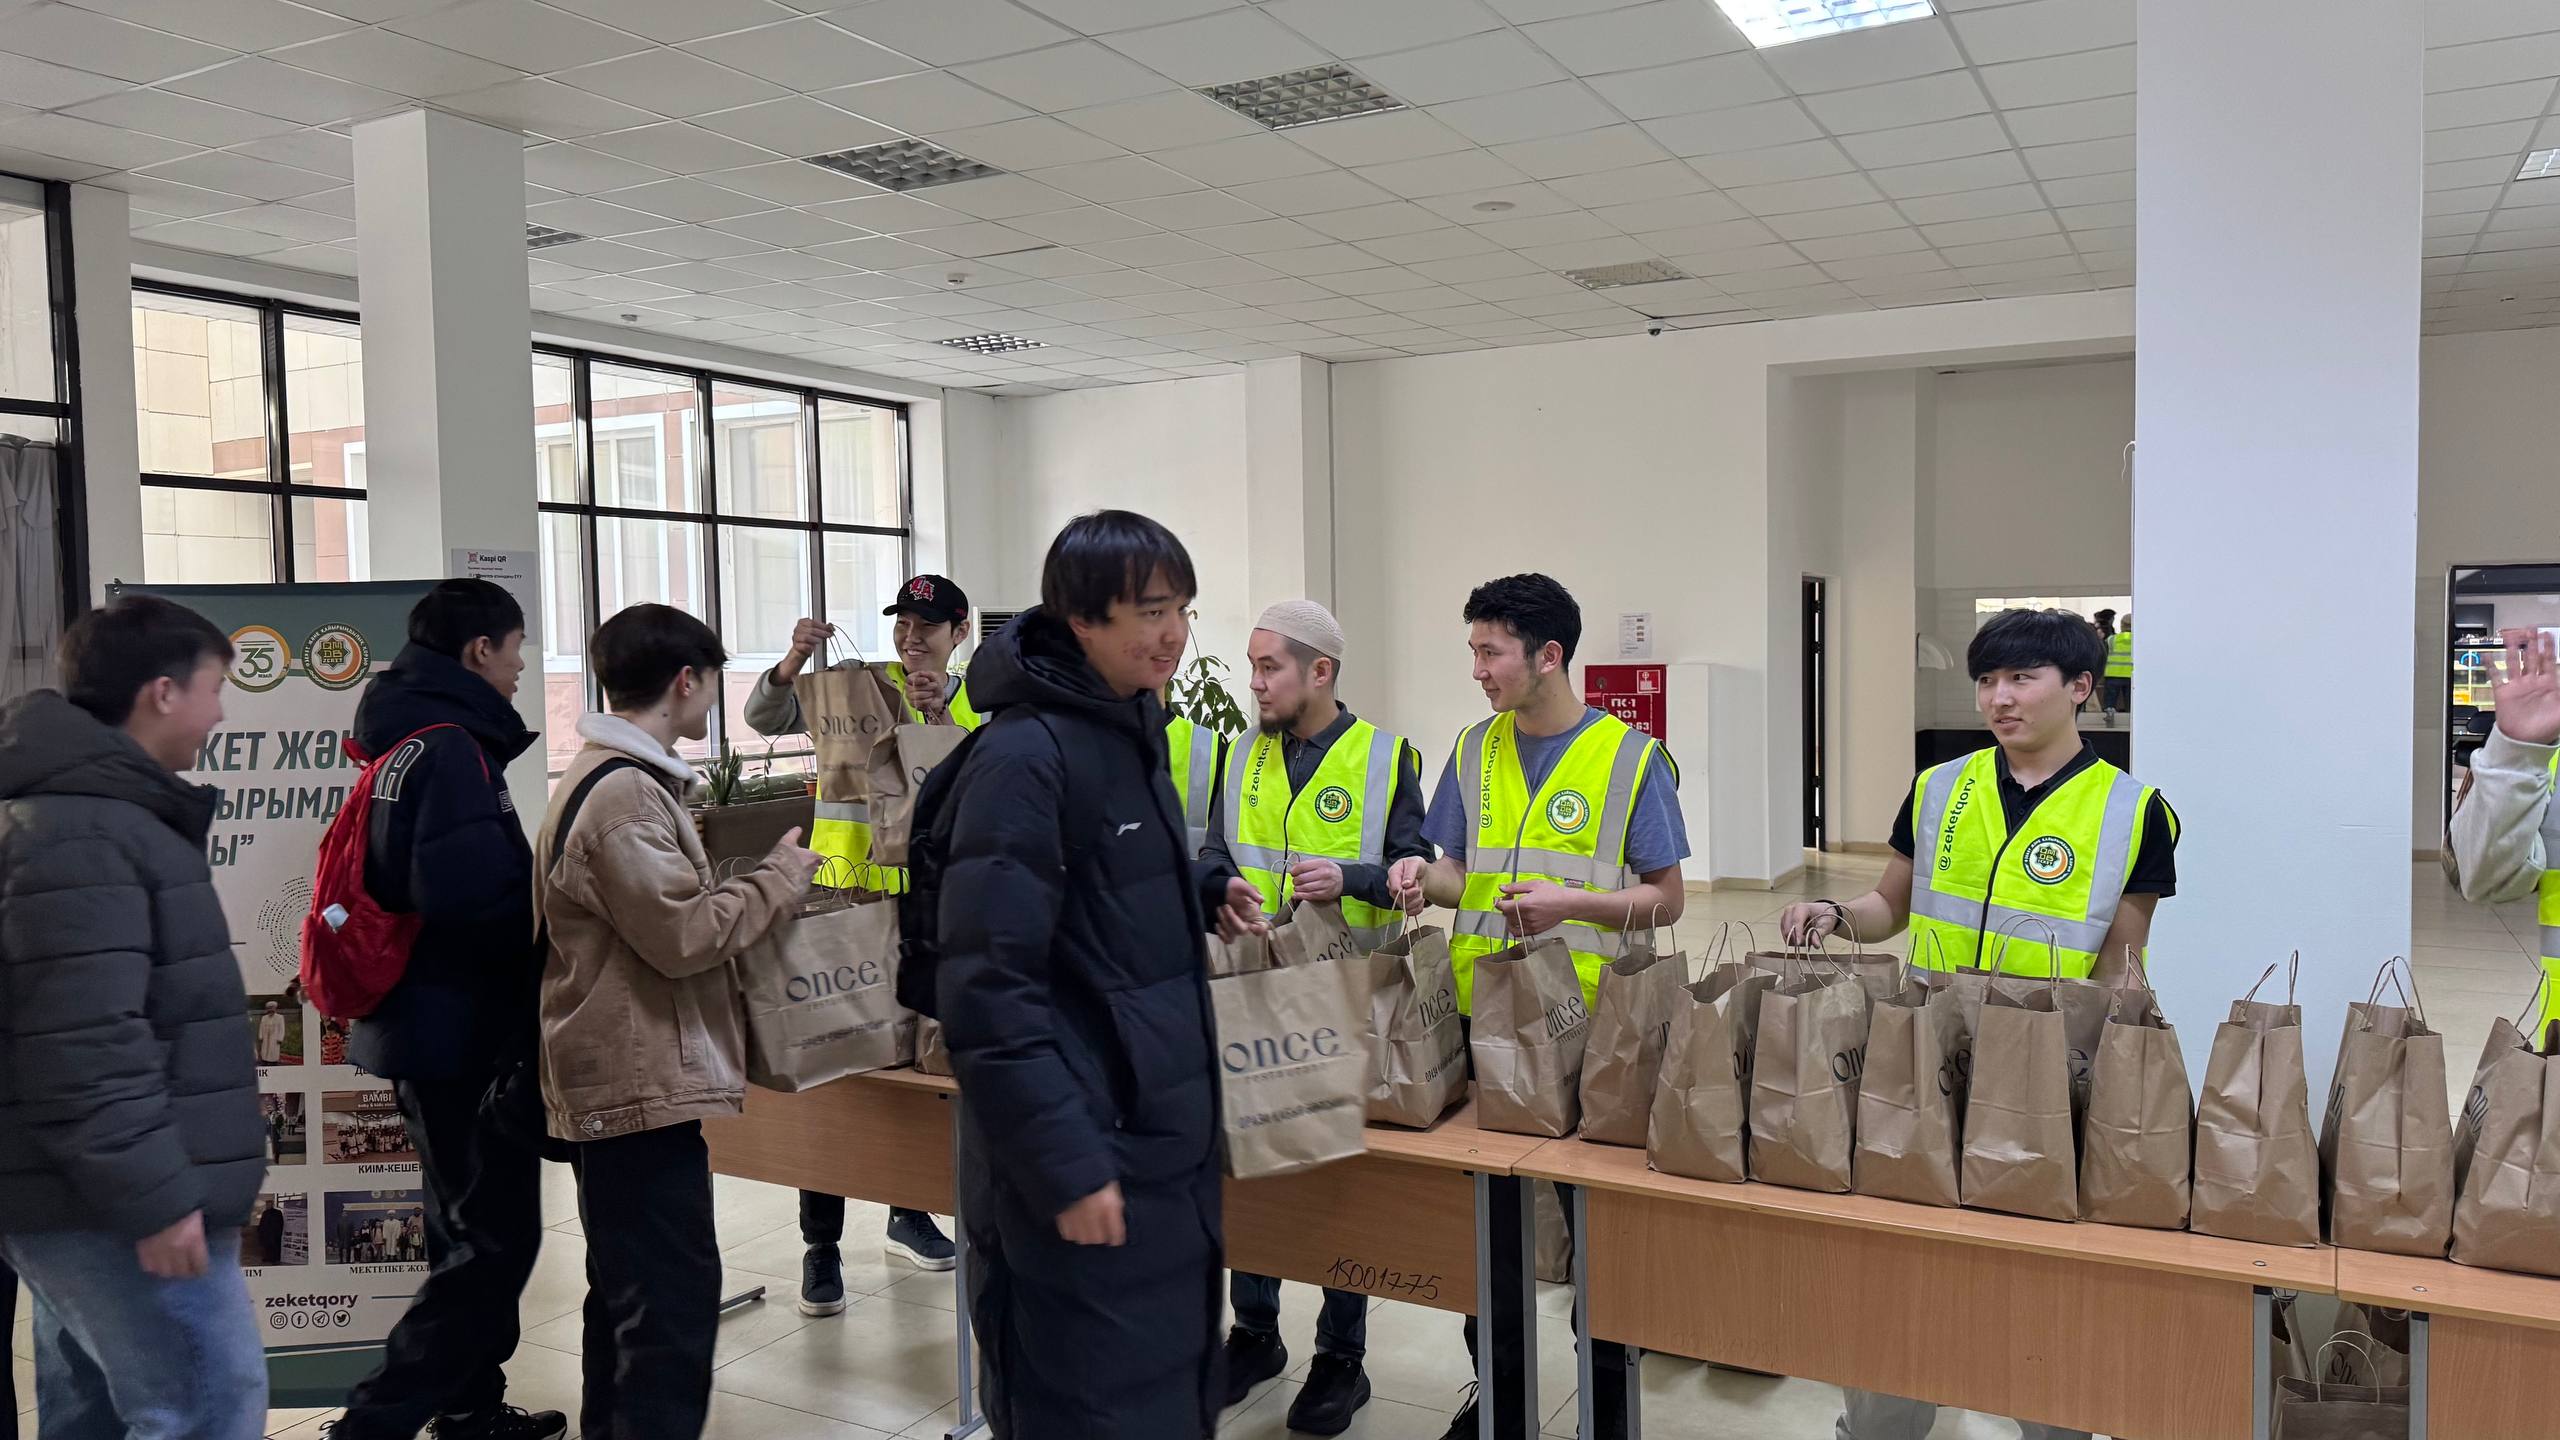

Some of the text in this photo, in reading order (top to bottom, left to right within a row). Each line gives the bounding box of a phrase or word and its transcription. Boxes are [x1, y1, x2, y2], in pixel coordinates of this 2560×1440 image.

[480, 555, 496, 563] Kaspi
[239, 648, 275, 678] 35
[1616, 710, 1637, 719] 101
[1942, 777, 1976, 853] zeketqory
[786, 960, 879, 1002] once
[1544, 996, 1587, 1038] once
[1223, 1027, 1339, 1074] once
[1832, 1043, 1867, 1083] on
[362, 1092, 393, 1104] BAMBI
[349, 1264, 405, 1275] МЕКТЕПКЕ
[265, 1293, 359, 1309] zeketqory
